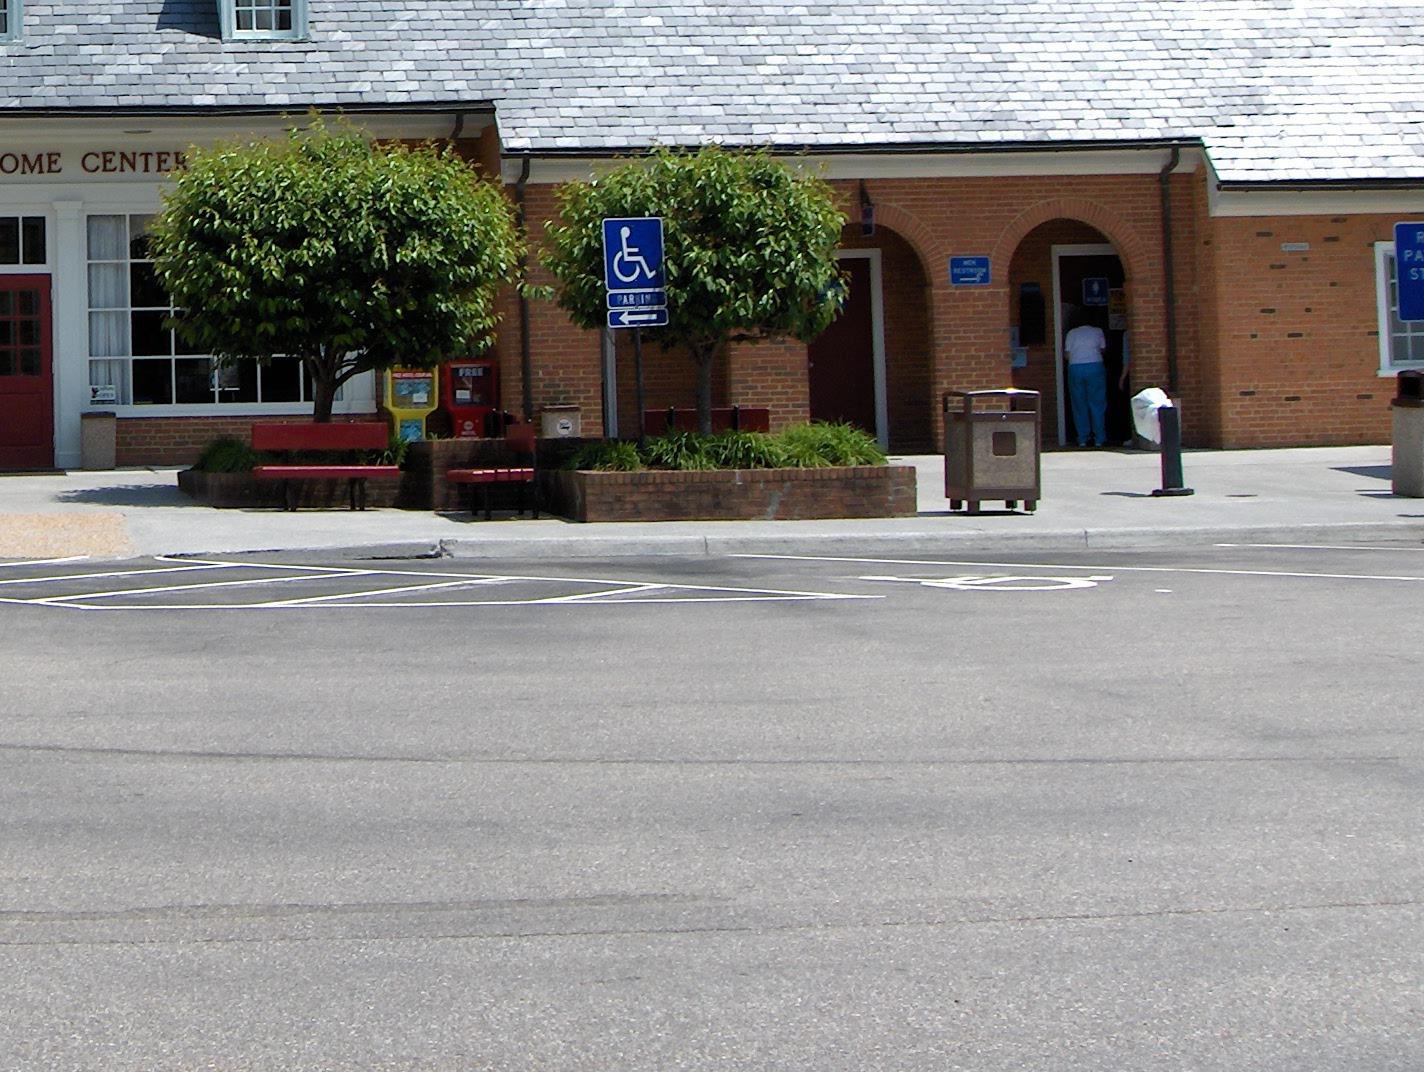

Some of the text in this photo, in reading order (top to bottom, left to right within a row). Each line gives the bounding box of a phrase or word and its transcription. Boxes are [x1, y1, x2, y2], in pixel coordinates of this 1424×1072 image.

[81, 151, 189, 173] CENTER
[1404, 249, 1424, 261] PA
[617, 294, 657, 305] PARKIN
[458, 368, 484, 376] FREE
